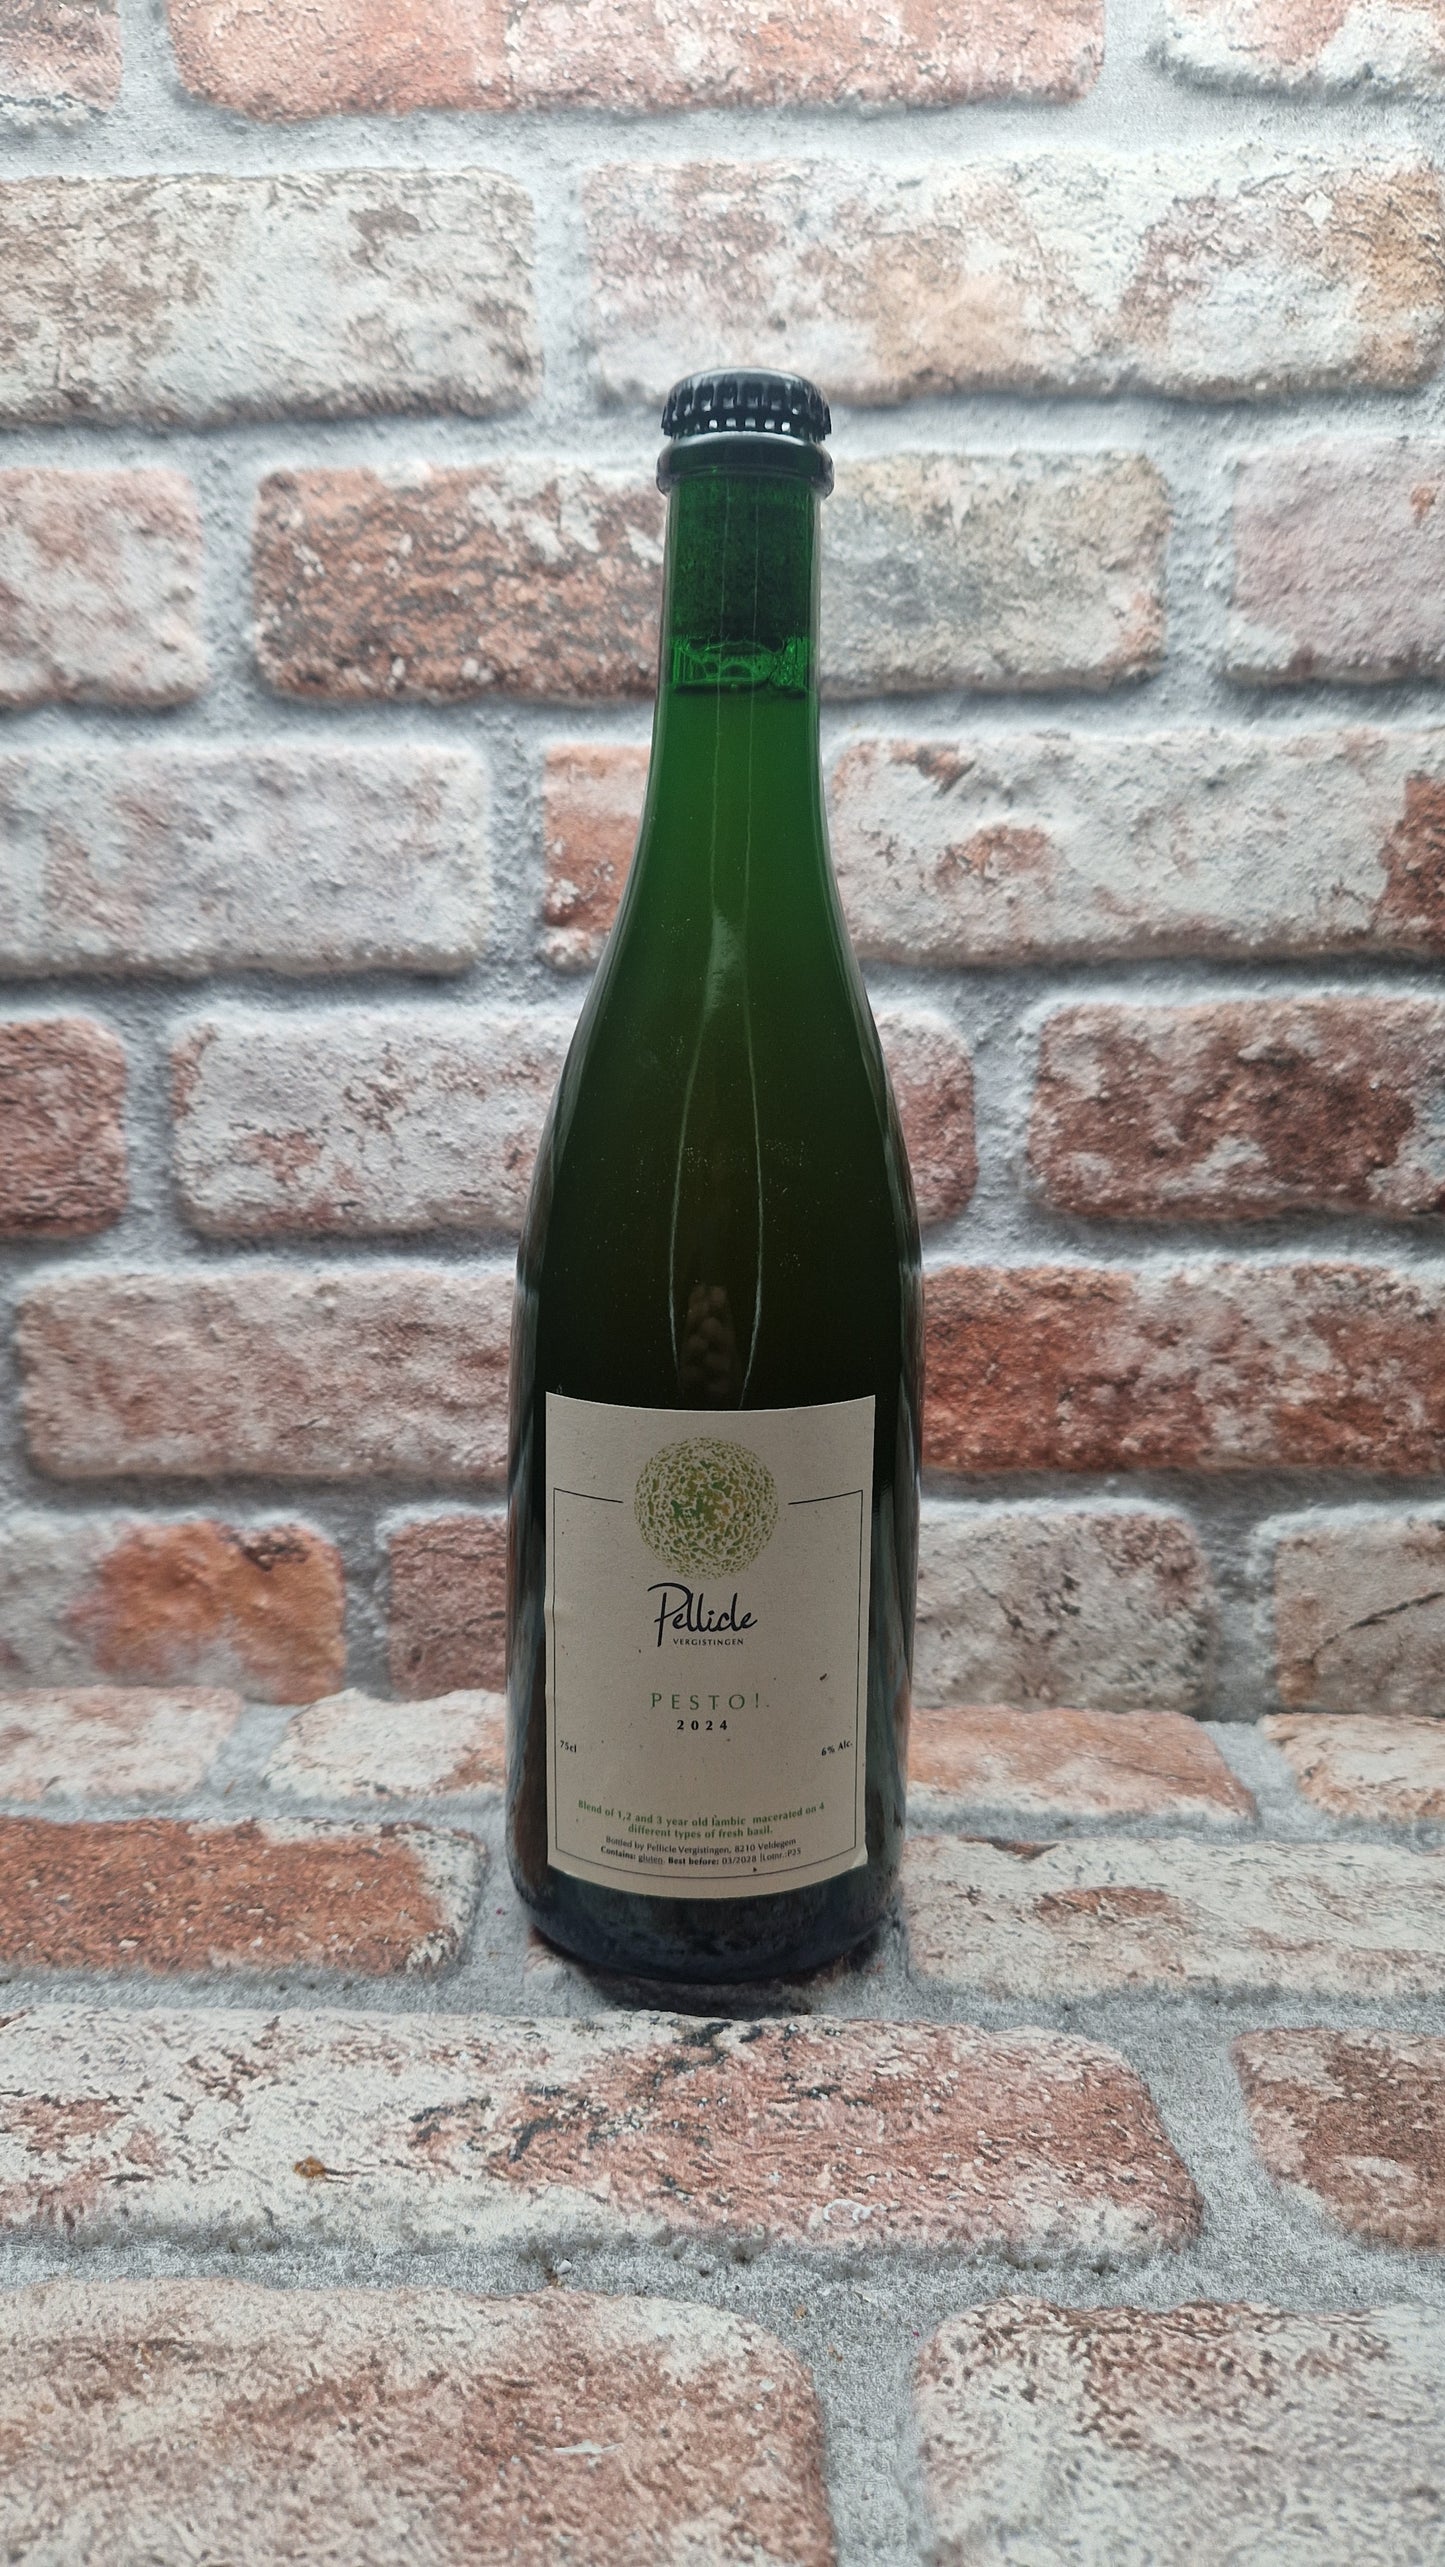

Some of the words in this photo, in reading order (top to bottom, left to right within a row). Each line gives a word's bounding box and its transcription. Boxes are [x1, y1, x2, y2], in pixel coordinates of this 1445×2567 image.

[647, 1582, 758, 1647] Pellicle
[673, 1638, 744, 1646] VERGISTINGEN
[651, 1692, 759, 1711] PESTO!
[676, 1719, 728, 1731] 2024
[560, 1740, 577, 1753] 75cl
[821, 1745, 835, 1756] 6%
[837, 1739, 853, 1751] Alc.
[578, 1799, 602, 1814] Blend
[605, 1808, 614, 1817] of
[617, 1811, 632, 1821] 1,2
[635, 1814, 653, 1824] and
[656, 1815, 662, 1825] 3
[666, 1818, 688, 1827] year
[691, 1816, 708, 1827] old
[711, 1815, 746, 1827] lambic
[752, 1808, 803, 1824] macerated
[805, 1806, 817, 1814] on
[818, 1801, 825, 1811] 4
[628, 1823, 671, 1837] different
[674, 1829, 701, 1840] types
[705, 1829, 715, 1838] of
[718, 1826, 743, 1838] fresh
[746, 1824, 773, 1836] basil.
[605, 1835, 632, 1849] Bottled
[634, 1841, 645, 1851] by
[646, 1843, 677, 1854] Pellicle
[677, 1845, 731, 1857] Vergistingen,
[734, 1844, 756, 1853] 8210
[758, 1837, 797, 1851] Veldegem
[600, 1845, 636, 1860] Contains:
[668, 1856, 686, 1865] Best
[688, 1855, 719, 1866] before:
[722, 1855, 757, 1865] 03/2028
